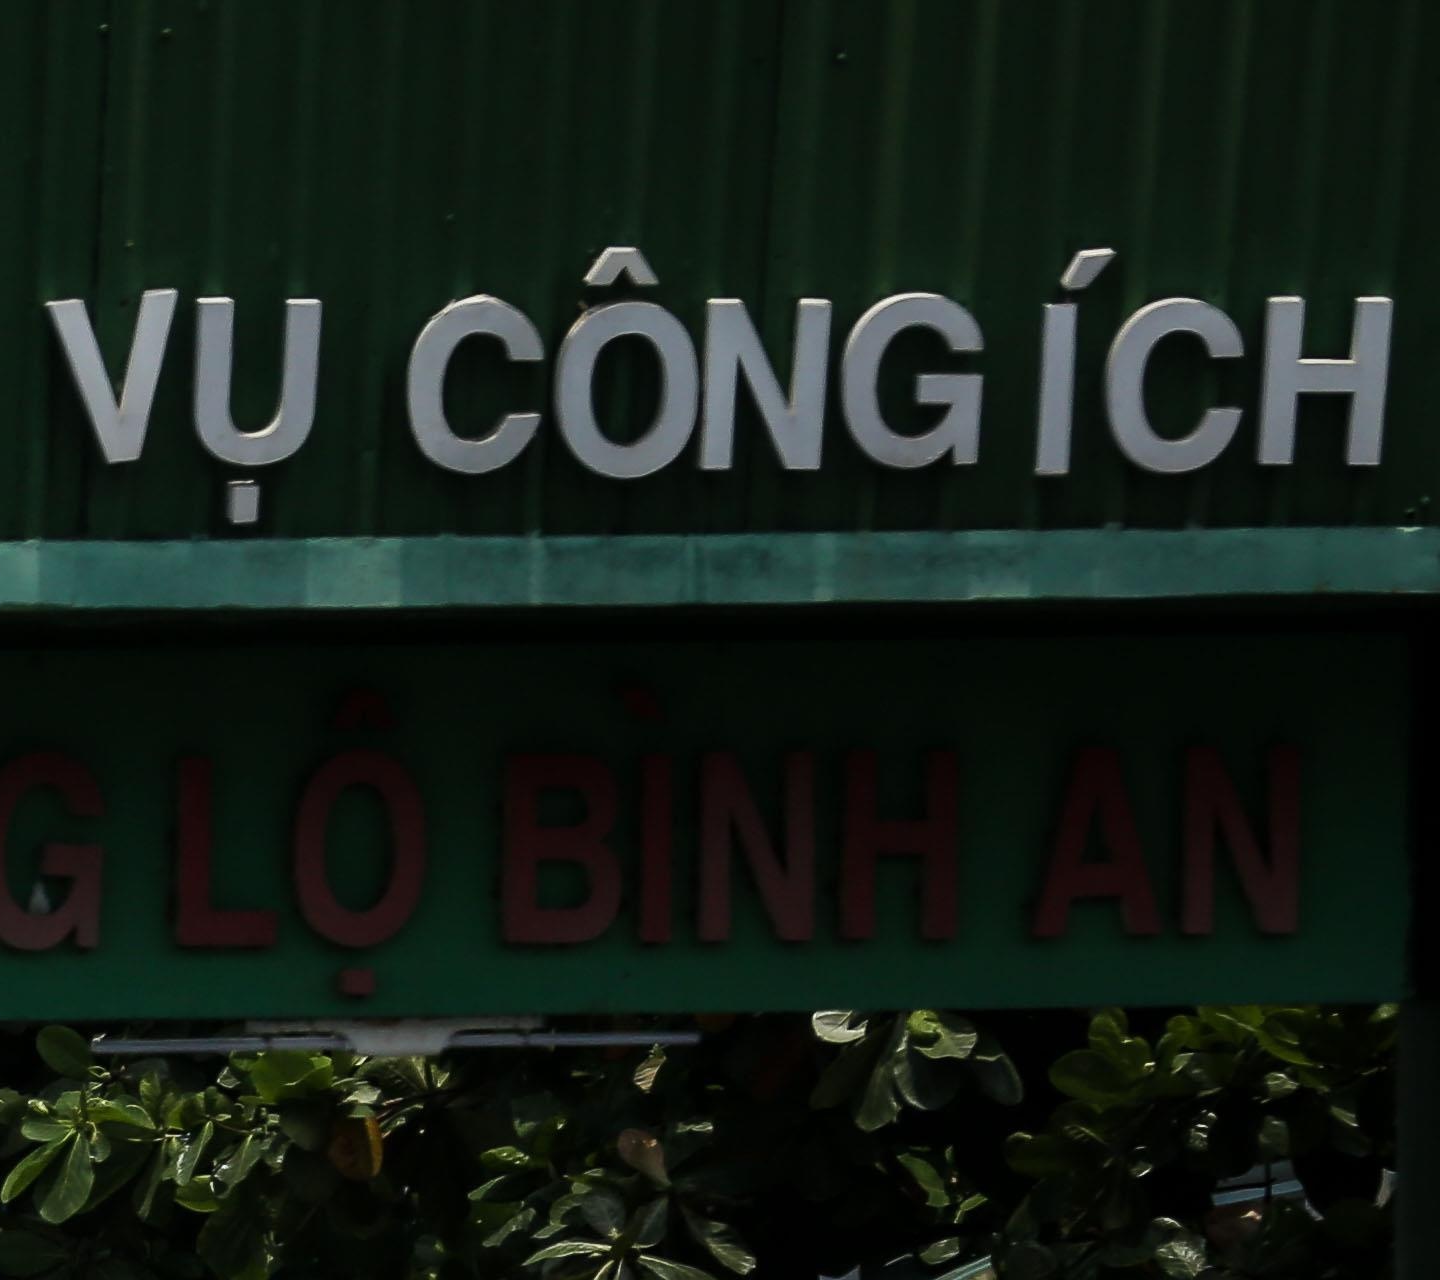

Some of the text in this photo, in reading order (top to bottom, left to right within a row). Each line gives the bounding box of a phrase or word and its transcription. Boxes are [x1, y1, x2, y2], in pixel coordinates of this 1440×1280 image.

[46, 288, 320, 522] VỤ
[409, 247, 981, 478] CÔNG
[1037, 248, 1392, 473] ÍCH
[175, 689, 428, 997] LỘ
[499, 684, 960, 944] BÌNH
[1032, 745, 1302, 938] AN
